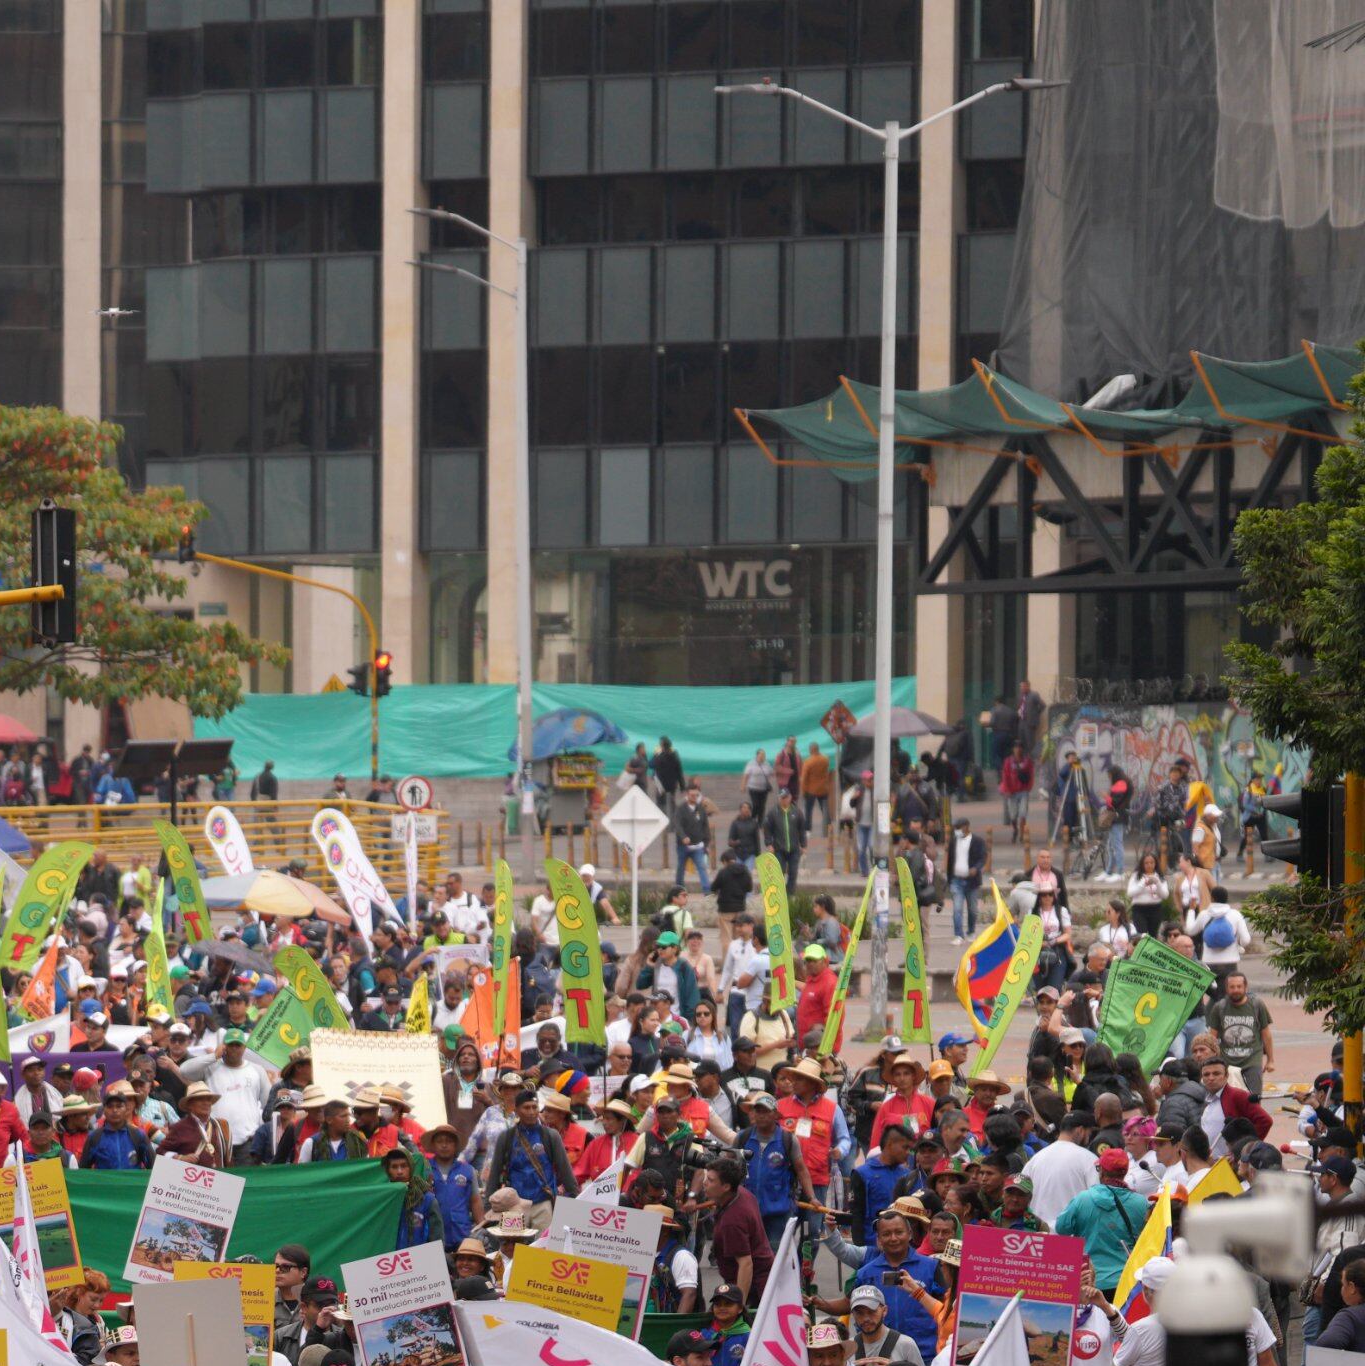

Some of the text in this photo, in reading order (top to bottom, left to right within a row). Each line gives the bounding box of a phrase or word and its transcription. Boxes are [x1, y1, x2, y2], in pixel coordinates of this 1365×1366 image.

[698, 559, 792, 597] WTC
[183, 1167, 215, 1188] SAE
[151, 1186, 181, 1201] 30 mil
[589, 1208, 627, 1230] SAE
[595, 1232, 641, 1246] Mochalito
[1003, 1234, 1044, 1257] SAE
[376, 1252, 412, 1275] SAE
[550, 1259, 591, 1285] SAE
[1005, 1258, 1034, 1268] bienes
[355, 1280, 445, 1307] 30 mil hectáreas para
[369, 1274, 427, 1293] Ya entregamos
[527, 1280, 604, 1302] Finca Bellavista
[1019, 1278, 1045, 1287] Ahora
[372, 1298, 412, 1313] revolución
[415, 1291, 441, 1303] agraria
